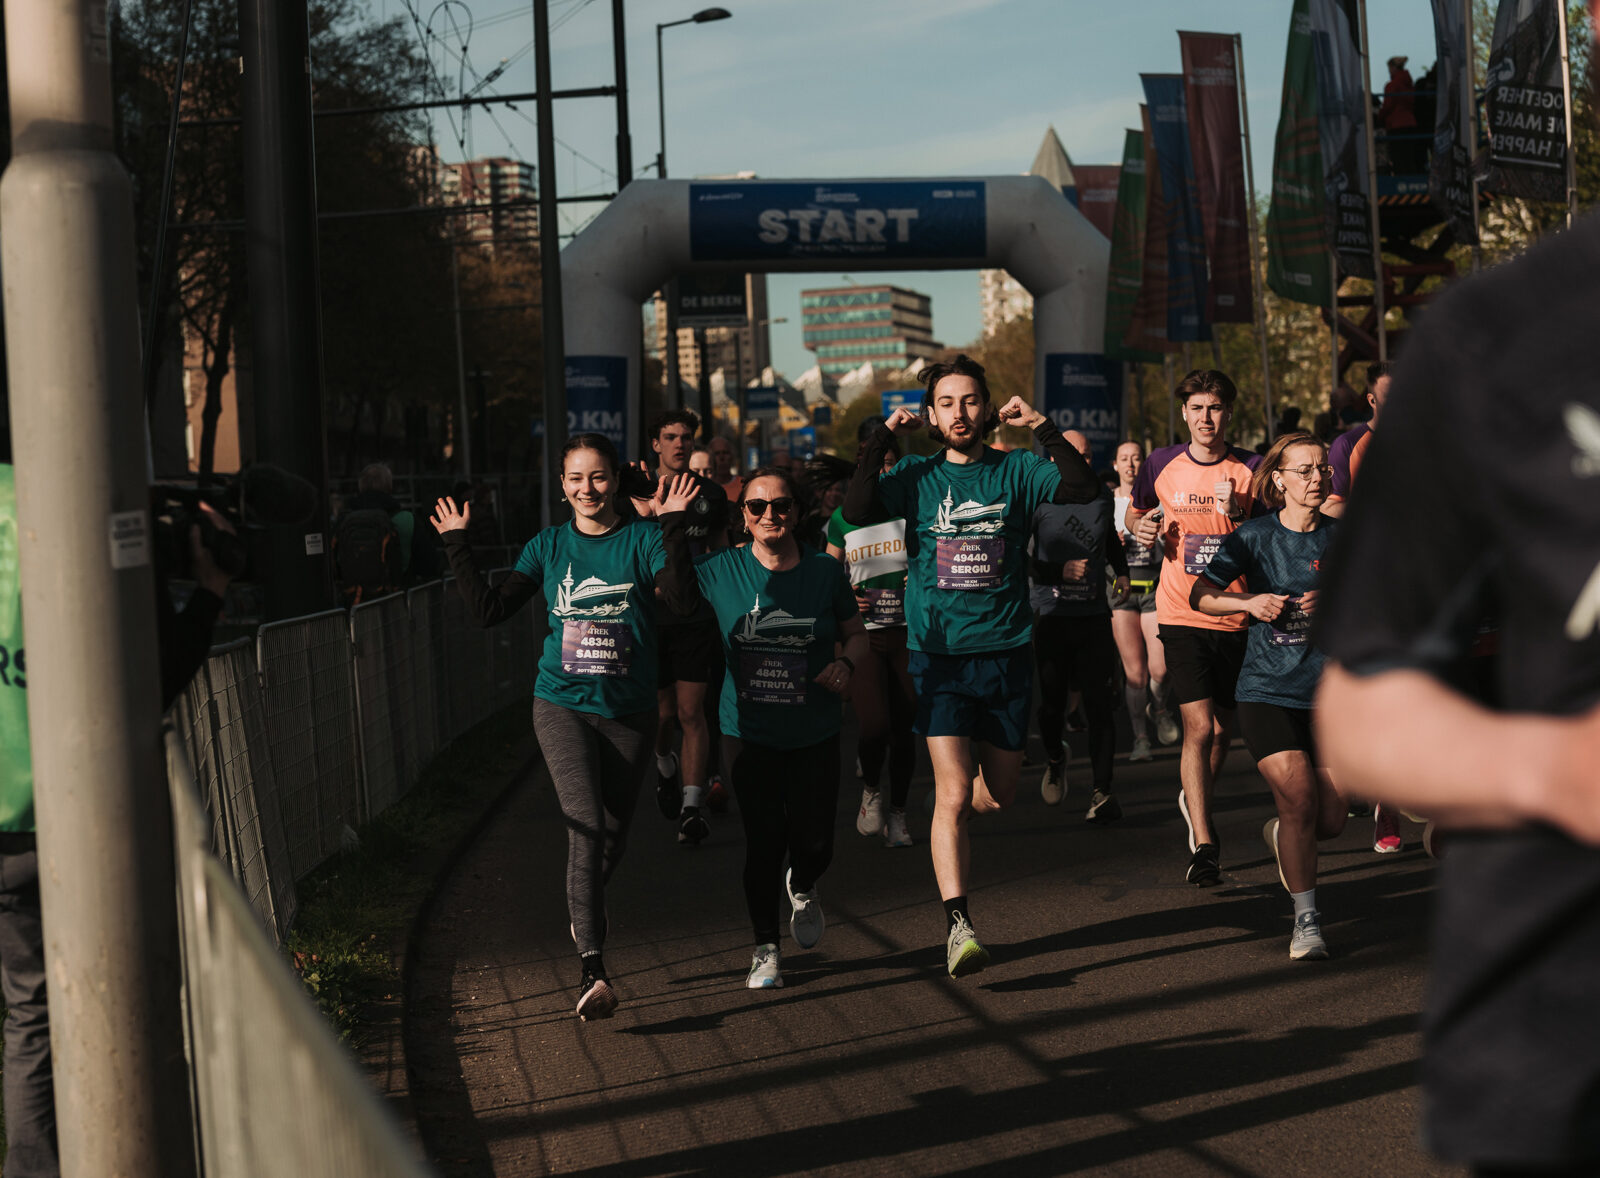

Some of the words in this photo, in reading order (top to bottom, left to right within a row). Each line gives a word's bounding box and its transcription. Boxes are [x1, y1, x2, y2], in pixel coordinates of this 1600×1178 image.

[757, 208, 919, 244] START
[582, 411, 622, 430] KM
[1080, 408, 1118, 429] KM
[1189, 494, 1214, 504] Run
[846, 538, 906, 565] ROTTERD
[953, 553, 988, 562] 49440
[951, 564, 991, 574] SERGIU
[581, 637, 616, 647] 48348
[576, 648, 619, 660] SABINA
[756, 668, 789, 678] 48474
[750, 679, 795, 690] PETRUTA
